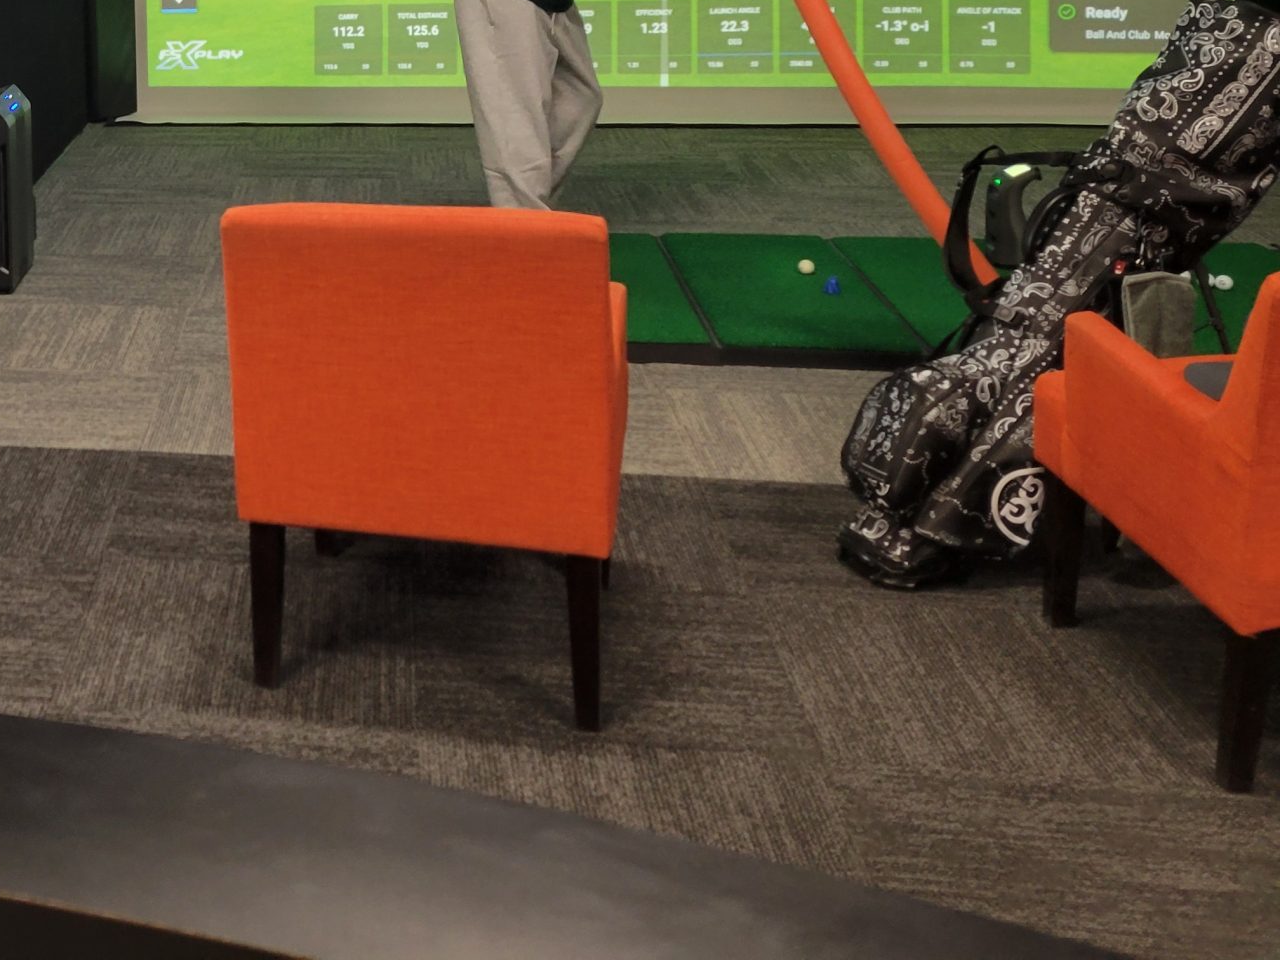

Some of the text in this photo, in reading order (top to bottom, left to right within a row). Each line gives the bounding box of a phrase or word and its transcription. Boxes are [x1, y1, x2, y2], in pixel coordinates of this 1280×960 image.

[993, 7, 1022, 15] ATTACK
[1085, 6, 1129, 21] Ready
[332, 26, 365, 37] 112.2
[406, 25, 439, 36] 125.6
[640, 23, 668, 34] 1.23
[721, 20, 750, 32] 22.3
[981, 21, 996, 33] -1
[1085, 29, 1104, 40] Ball
[1106, 29, 1126, 40] And
[1128, 29, 1150, 40] Club
